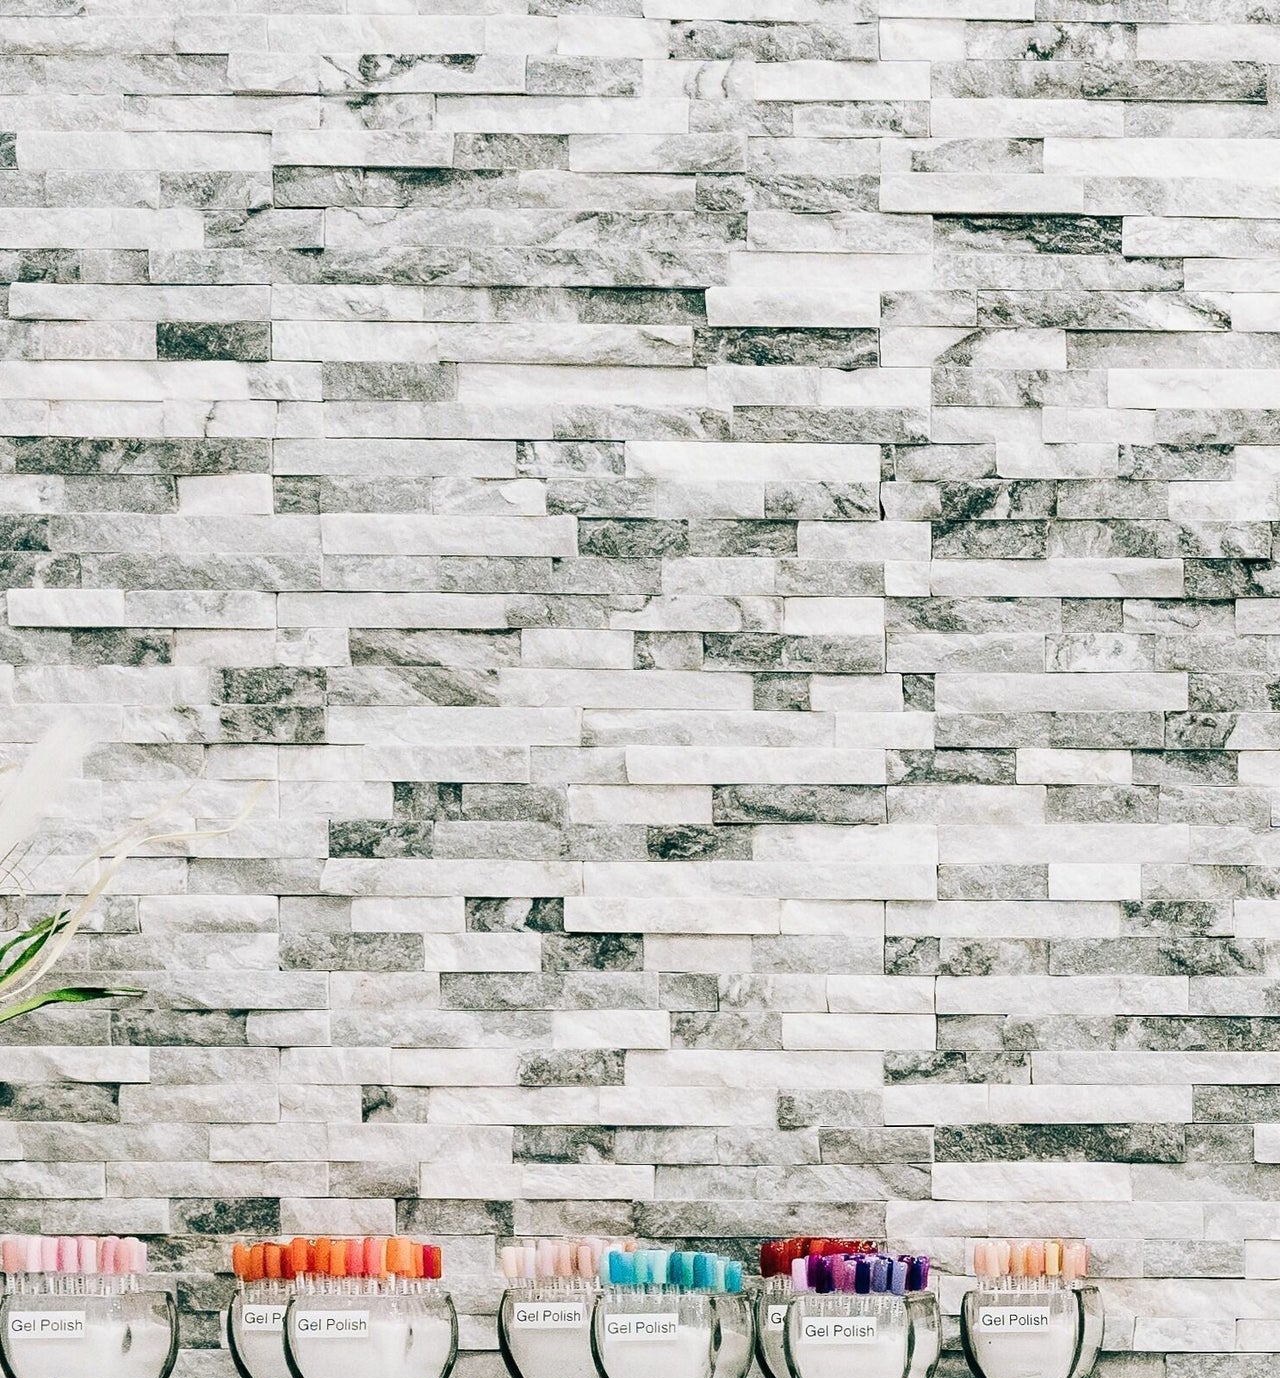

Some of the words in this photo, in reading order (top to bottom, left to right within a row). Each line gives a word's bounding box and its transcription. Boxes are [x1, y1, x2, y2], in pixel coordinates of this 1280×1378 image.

[244, 1312, 268, 1326] Gel
[515, 1309, 539, 1323] Gel
[542, 1309, 582, 1323] Polish
[981, 1313, 1006, 1327] Gel
[1008, 1313, 1049, 1328] Polish
[10, 1319, 37, 1333] Gel
[40, 1318, 84, 1333] Polish
[297, 1318, 322, 1332] Gel
[326, 1318, 368, 1332] Polish
[607, 1321, 632, 1335] Gel
[635, 1320, 677, 1335] Polish
[804, 1324, 830, 1338] Gel
[833, 1324, 876, 1339] Polish
